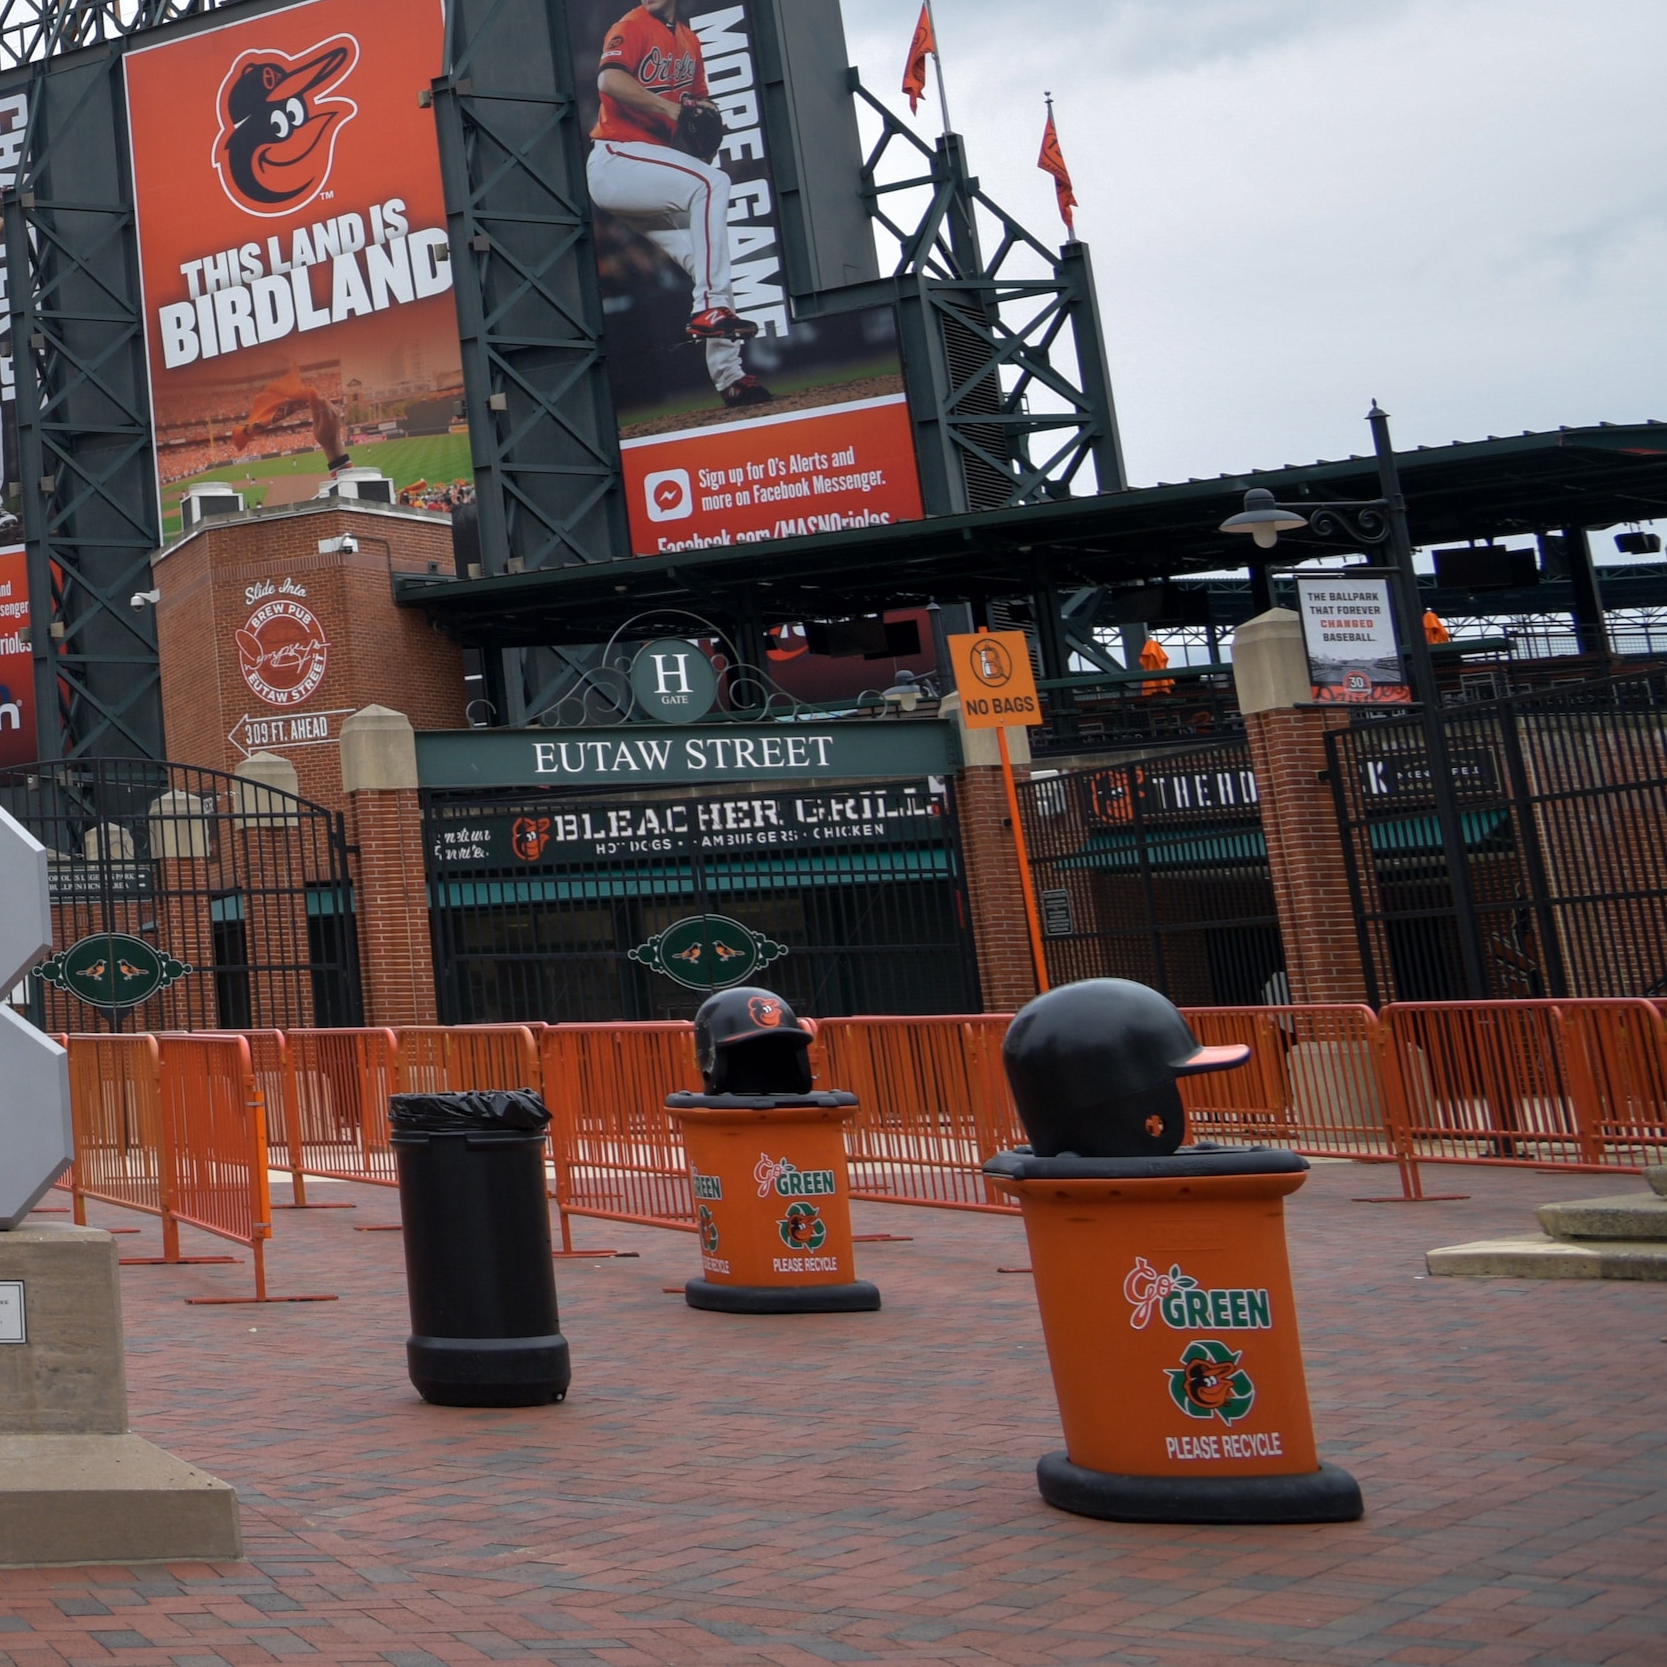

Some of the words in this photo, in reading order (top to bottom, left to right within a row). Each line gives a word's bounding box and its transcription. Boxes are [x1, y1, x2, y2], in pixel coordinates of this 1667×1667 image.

[689, 5, 764, 173] MORE
[180, 242, 264, 300] THIS
[267, 213, 365, 276] LAND
[369, 198, 409, 245] IS
[159, 227, 453, 369] BIRDLAND
[699, 469, 726, 490] Sign
[729, 468, 743, 486] up
[747, 462, 764, 480] for
[790, 453, 828, 474] Alerts
[831, 446, 854, 467] and
[702, 493, 733, 511] more
[735, 491, 750, 506] on
[754, 480, 810, 504] Facebook
[813, 469, 886, 495] Messenger.
[245, 580, 275, 605] Slide
[279, 577, 307, 598] Into
[1308, 593, 1325, 601] THE
[1329, 593, 1379, 601] BALLPARK
[251, 604, 284, 628] BREW
[289, 605, 312, 625] PUB
[1310, 606, 1333, 614] THAT
[1337, 606, 1381, 614] FOREVER
[1321, 620, 1373, 628] CHANGED
[248, 673, 287, 702] EUTAW
[291, 653, 324, 699] STREET
[650, 654, 693, 694] H
[1349, 677, 1363, 688] 30
[661, 695, 689, 704] GATE
[968, 699, 991, 715] NO
[995, 694, 1035, 714] BAGS
[245, 723, 267, 744] 309
[271, 722, 288, 742] FT.
[291, 717, 328, 740] AHEAD
[532, 738, 674, 774] EUTAW
[686, 736, 834, 771] STREET
[554, 799, 785, 842] BLEACHER
[776, 1170, 835, 1196] GREEN
[773, 1257, 803, 1272] PLEASE
[805, 1257, 837, 1271] RECYCLE
[1123, 1256, 1174, 1330] Go
[1160, 1289, 1272, 1329] GREEN
[1165, 1435, 1219, 1459] PLEASE
[1222, 1432, 1282, 1458] RECYCLE
